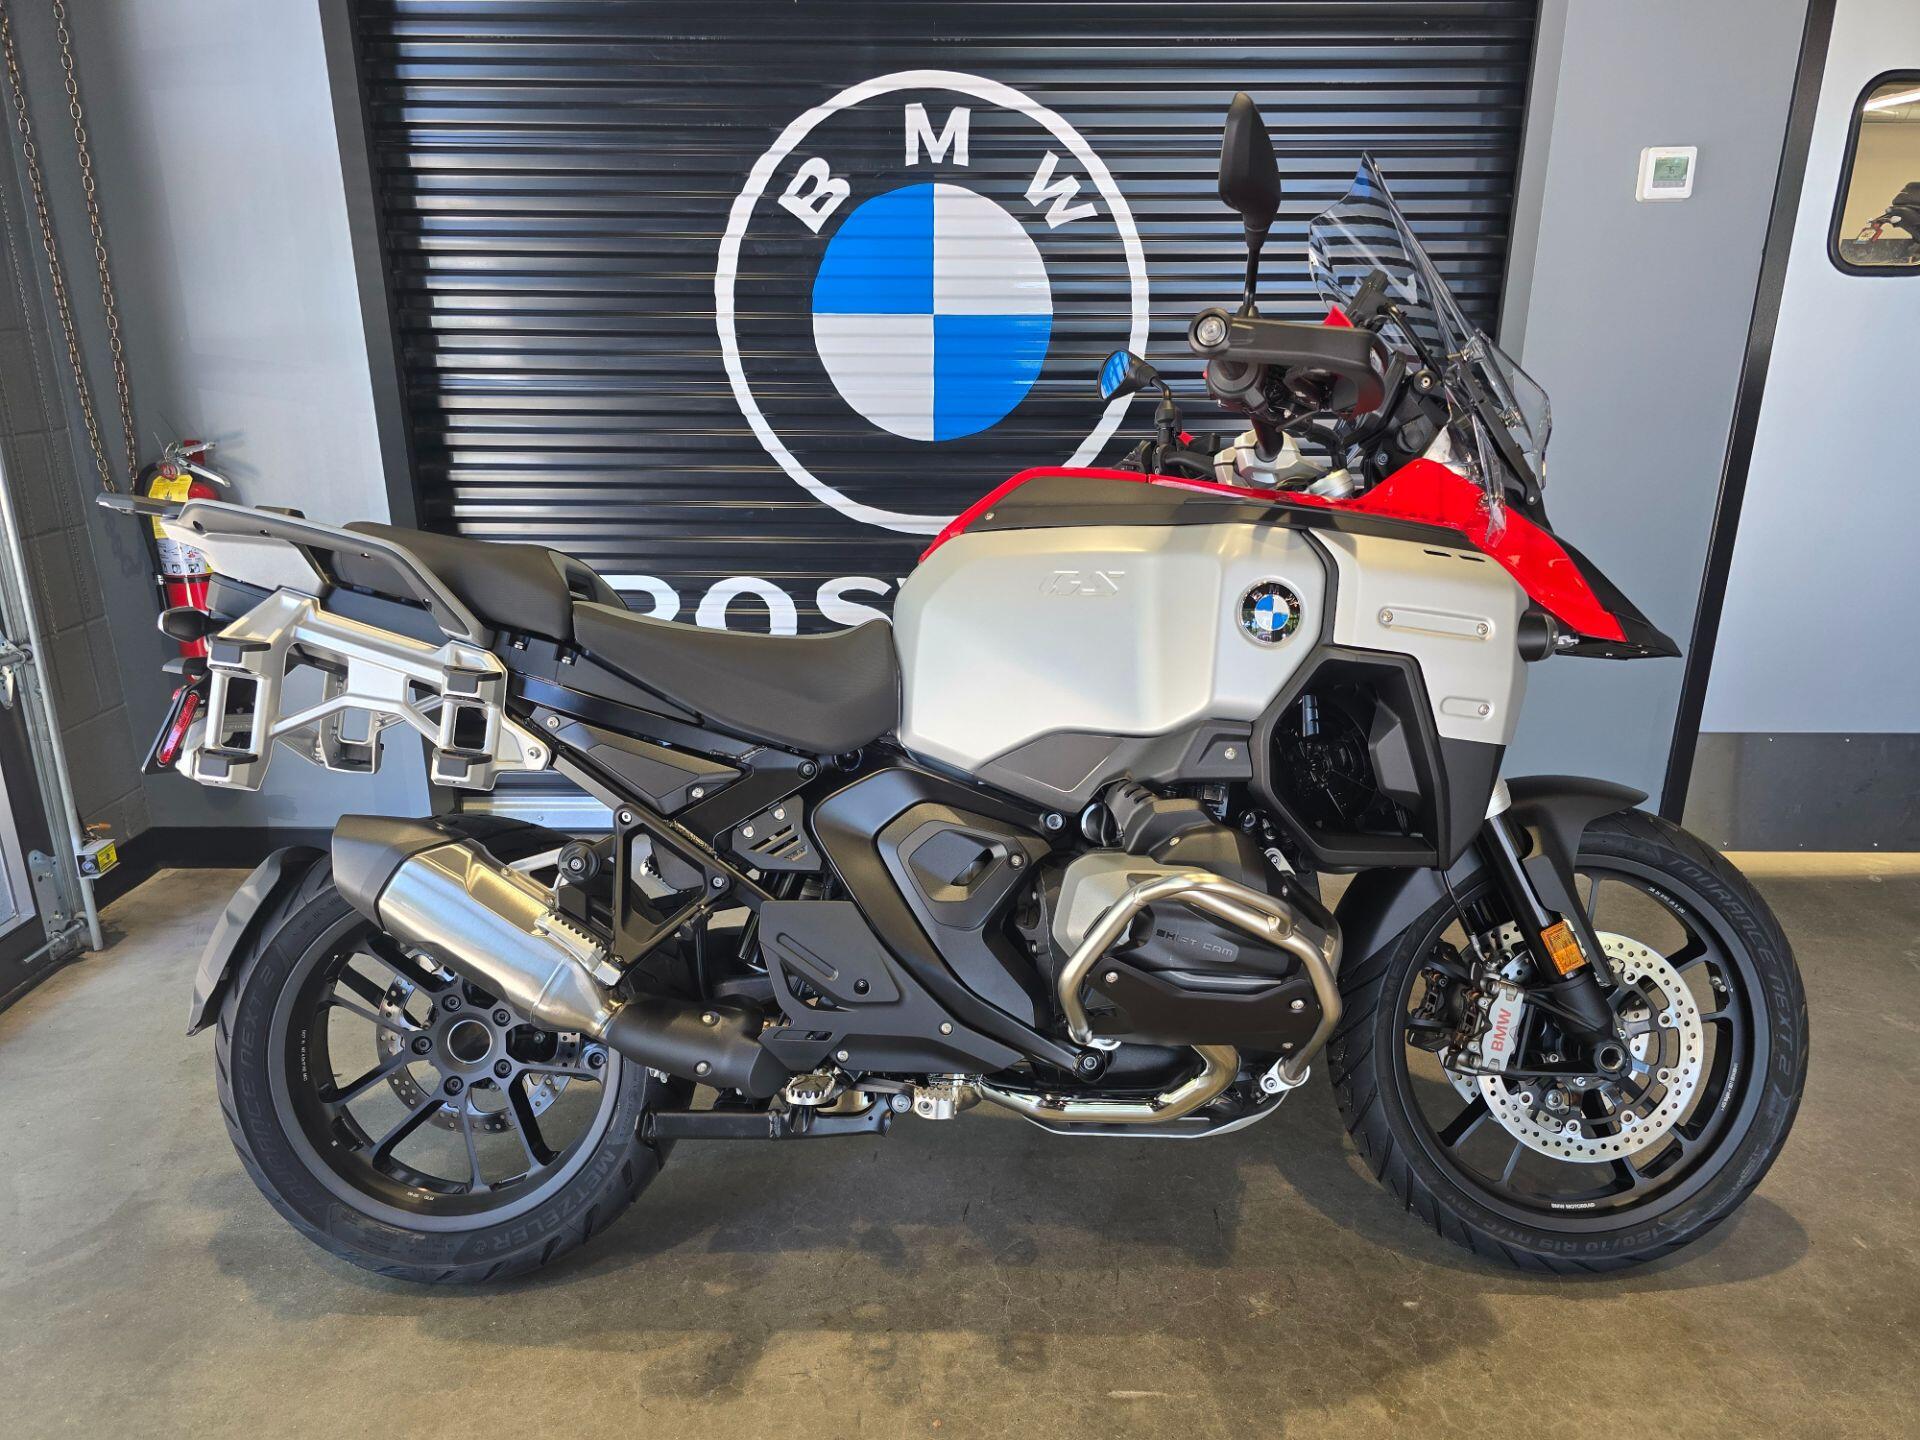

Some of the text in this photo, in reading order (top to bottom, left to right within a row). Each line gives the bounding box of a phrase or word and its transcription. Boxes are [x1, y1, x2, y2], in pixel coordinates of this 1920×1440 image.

[778, 103, 1098, 233] BMW
[1249, 583, 1300, 607] BMW
[1666, 850, 1777, 968] TOURANCE
[1768, 971, 1792, 1050] NEXT
[1490, 1008, 1512, 1053] BMW
[490, 1148, 622, 1250] METZELER
